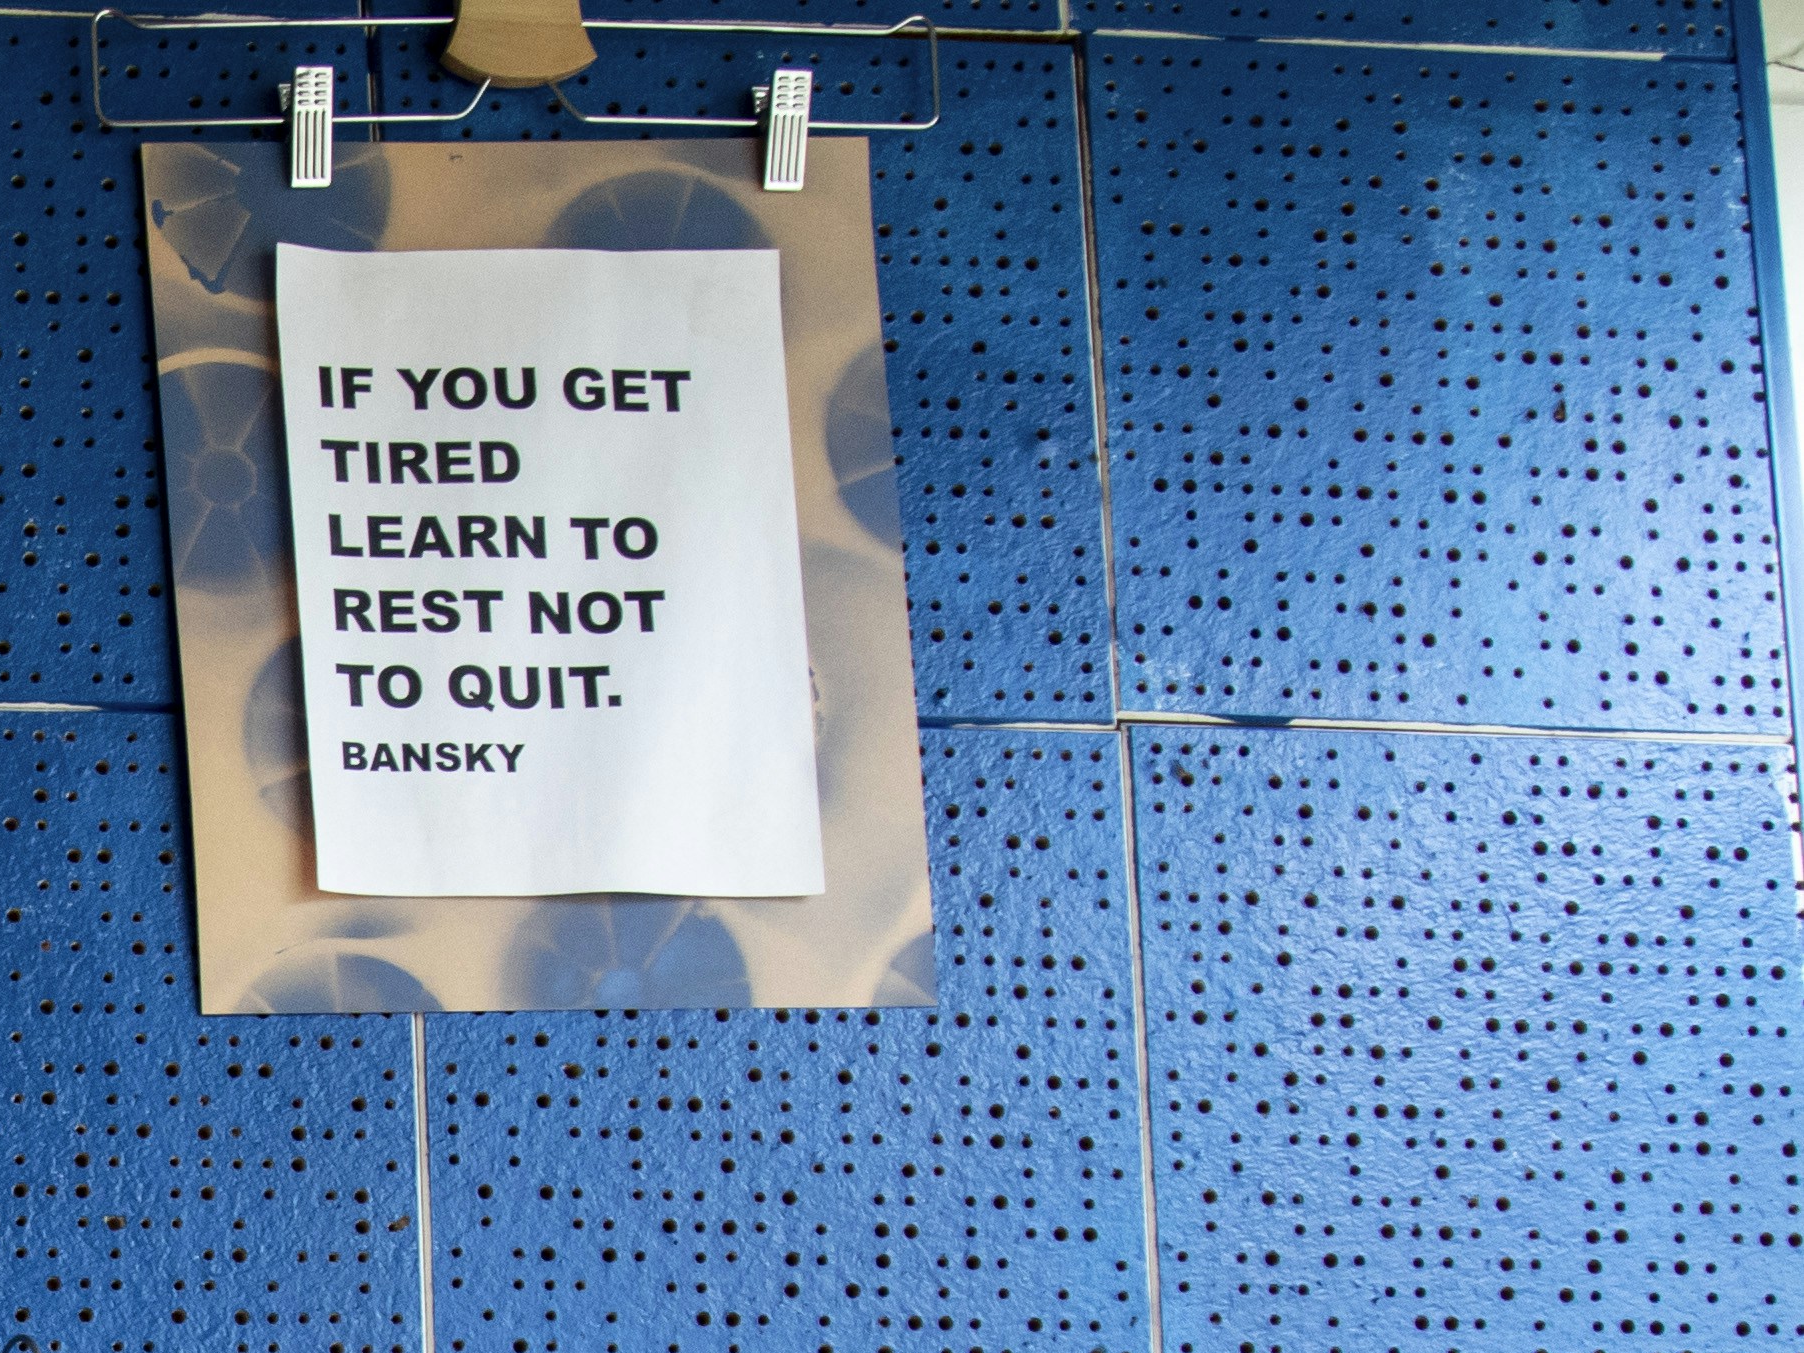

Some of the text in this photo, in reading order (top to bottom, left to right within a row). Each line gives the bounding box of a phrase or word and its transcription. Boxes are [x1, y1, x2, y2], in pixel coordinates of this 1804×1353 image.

[319, 366, 691, 412] IF YOU GET
[321, 439, 520, 484] TIRED
[329, 514, 658, 560] LEARN TO
[334, 589, 665, 634] REST NOT
[336, 663, 621, 711] TO QUIT.
[342, 742, 524, 772] BANSKY
